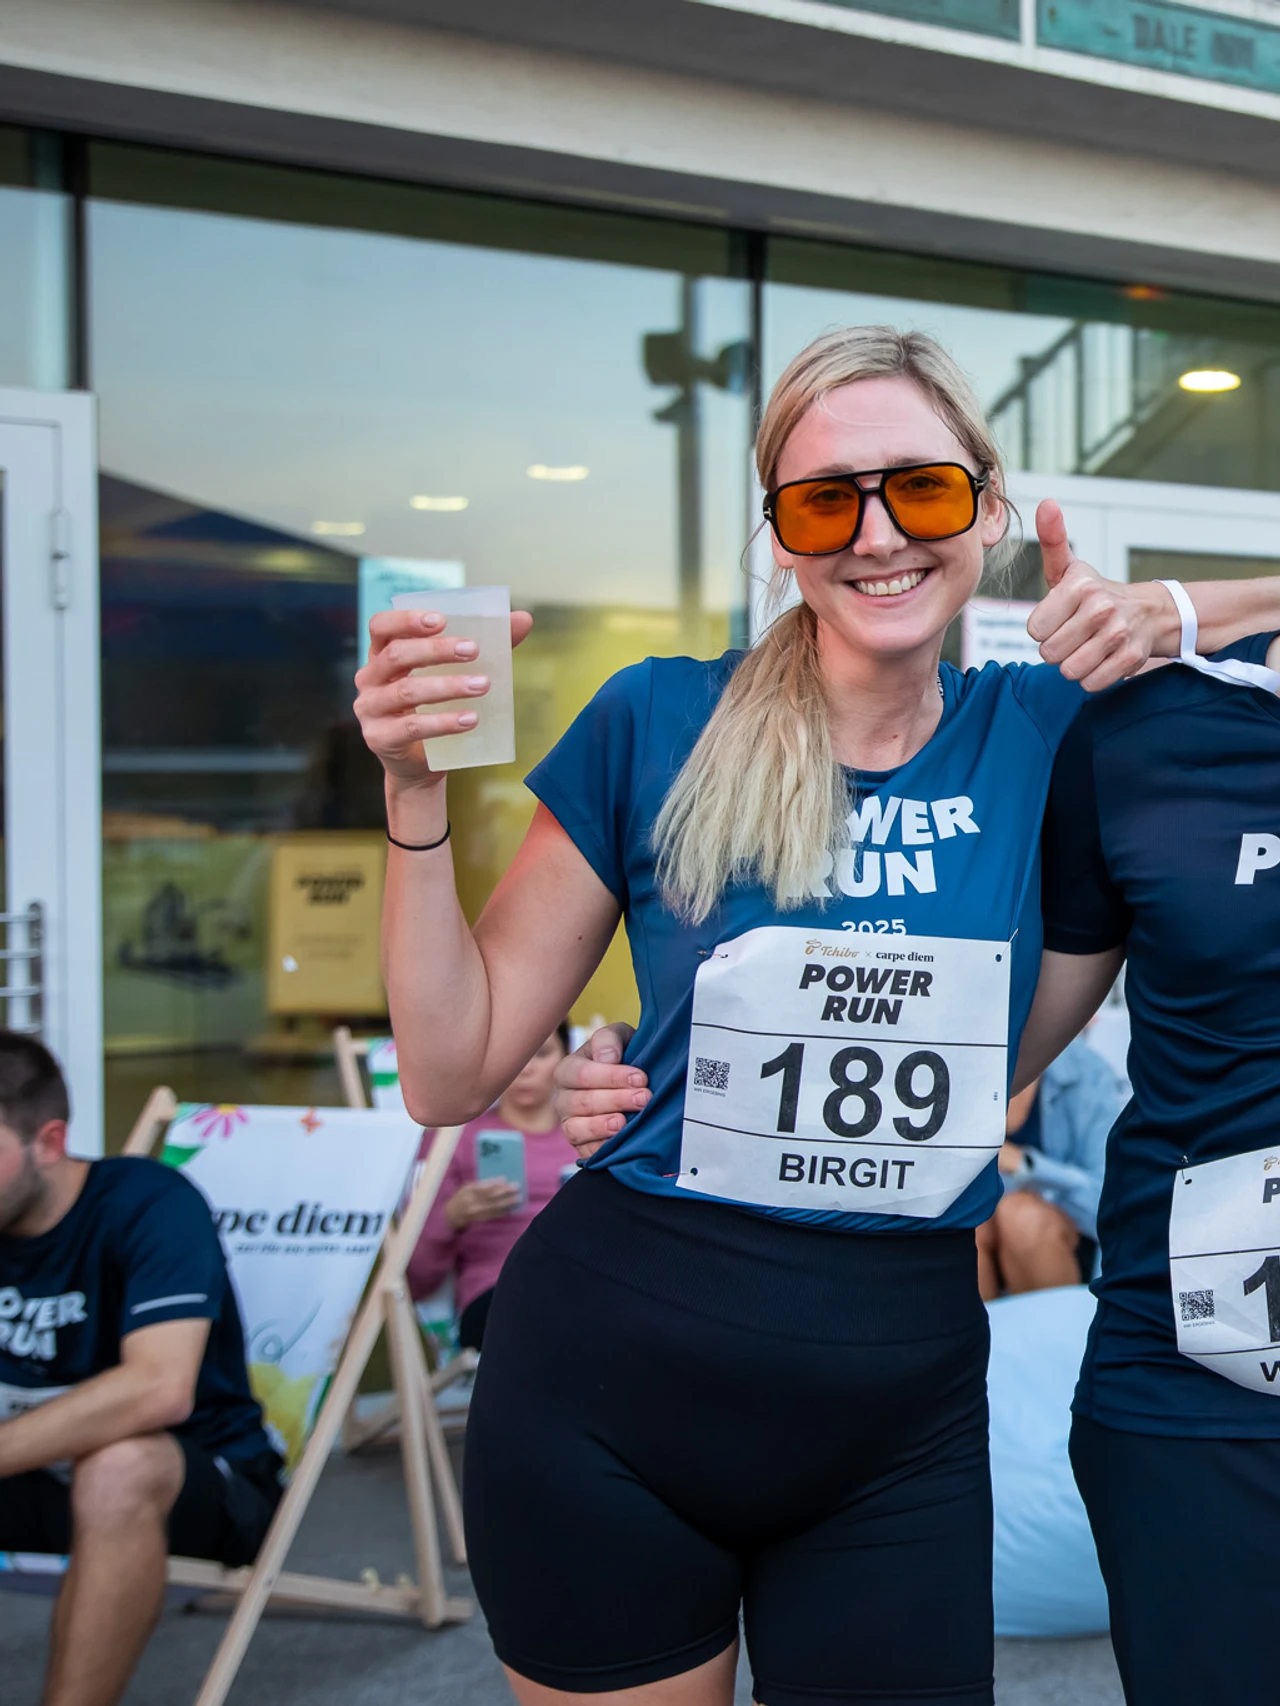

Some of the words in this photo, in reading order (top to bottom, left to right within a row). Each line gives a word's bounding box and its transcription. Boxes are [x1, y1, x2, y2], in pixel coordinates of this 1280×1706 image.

[845, 796, 981, 846] WER
[821, 945, 860, 958] Tchibo
[876, 951, 906, 962] carpe
[906, 952, 934, 962] diem
[799, 963, 933, 997] POWER
[821, 995, 903, 1025] RUN
[760, 1042, 951, 1142] 189
[778, 1153, 914, 1189] BIRGIT
[276, 1200, 383, 1236] diem
